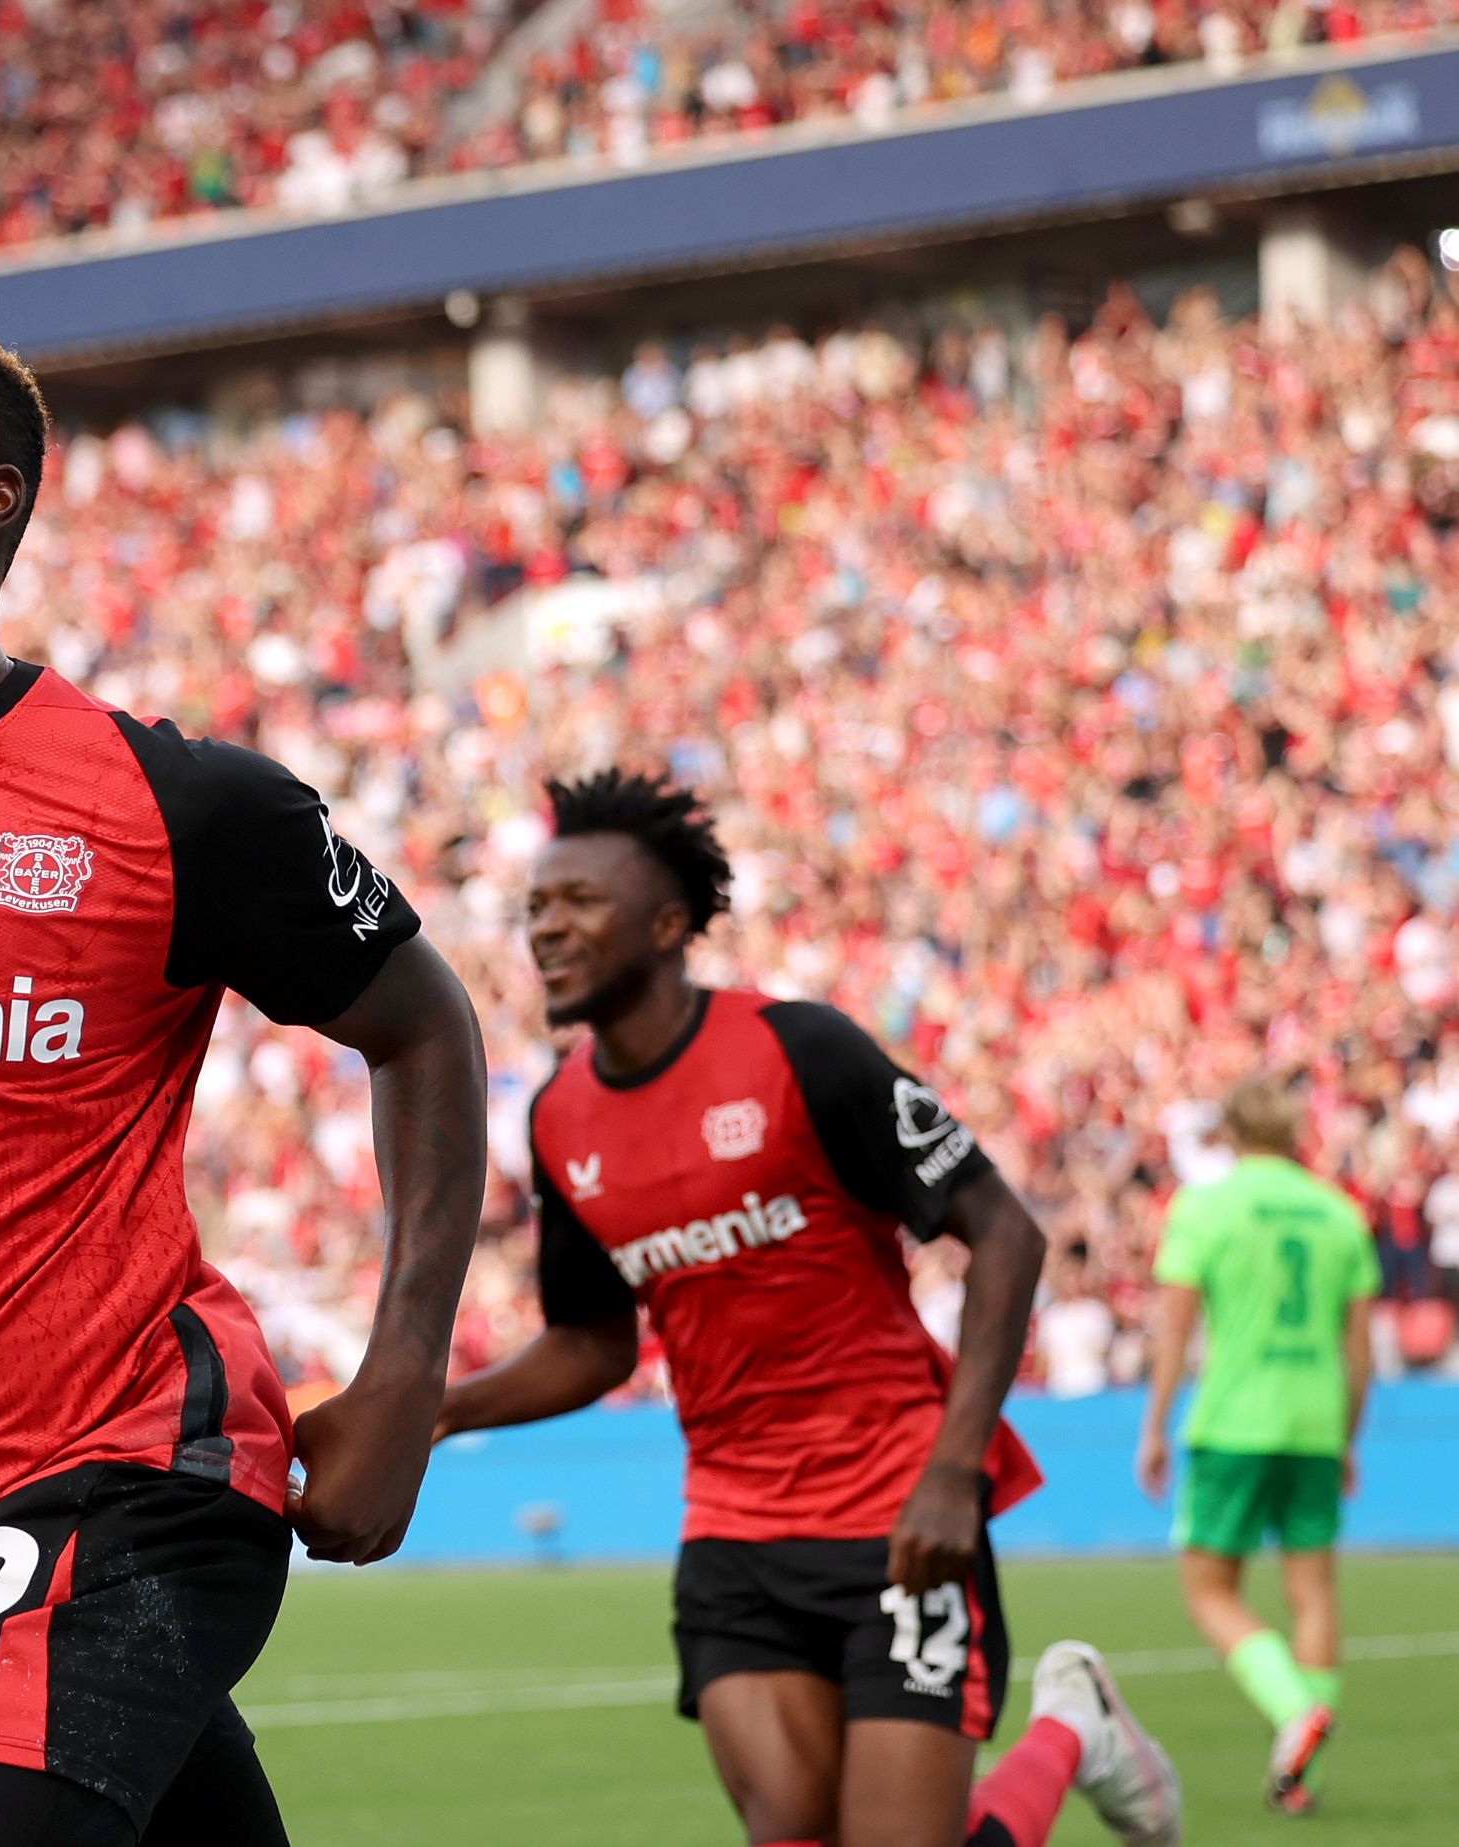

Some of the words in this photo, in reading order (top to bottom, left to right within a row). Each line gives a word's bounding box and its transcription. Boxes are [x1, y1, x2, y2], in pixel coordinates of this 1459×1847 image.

[27, 839, 53, 849] 1904
[14, 867, 59, 880] BAYER
[30, 853, 44, 894] BAYER
[915, 1121, 974, 1188] NIED
[610, 1192, 808, 1287] armenia
[880, 1582, 969, 1671] 12
